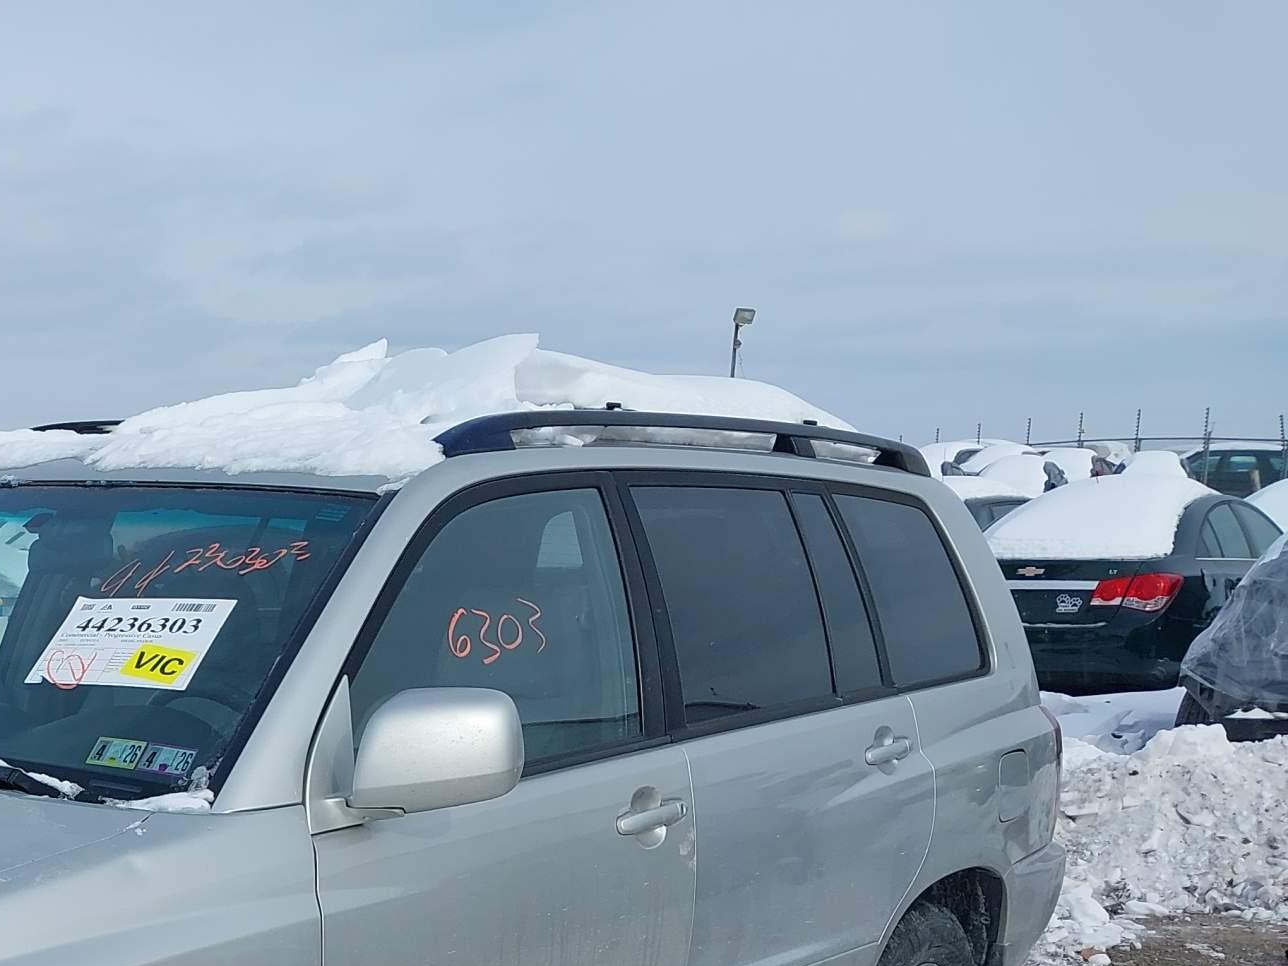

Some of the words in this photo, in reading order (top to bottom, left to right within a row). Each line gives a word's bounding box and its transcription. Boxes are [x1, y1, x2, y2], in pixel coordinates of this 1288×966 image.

[76, 616, 202, 633] 44236303
[447, 597, 546, 665] 6303
[133, 651, 185, 676] VIC
[123, 744, 142, 764] 26
[174, 751, 194, 772] 26
